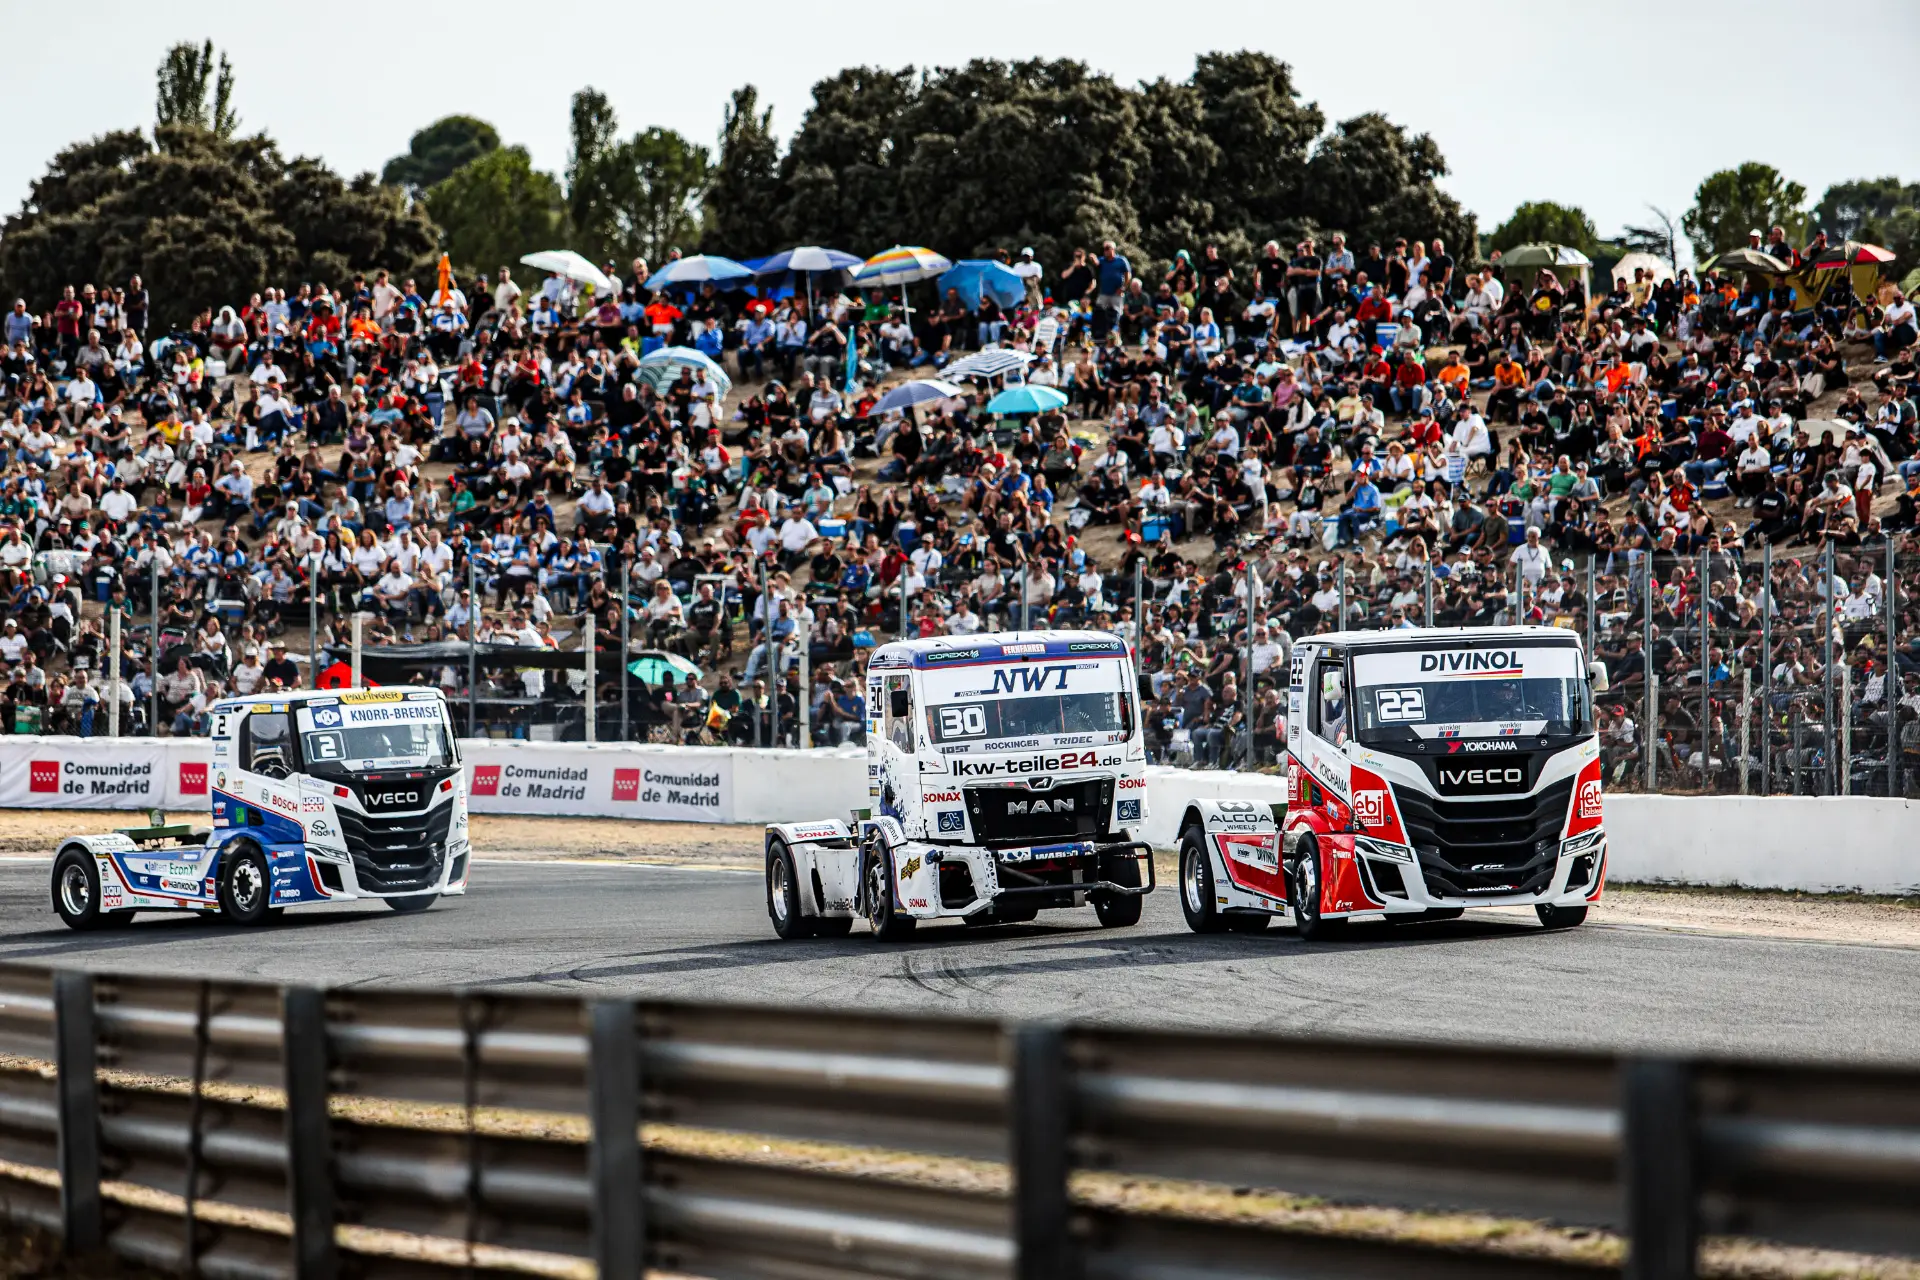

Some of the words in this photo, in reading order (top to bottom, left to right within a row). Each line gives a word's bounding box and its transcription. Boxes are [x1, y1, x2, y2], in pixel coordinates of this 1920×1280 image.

[1070, 643, 1110, 651] COREXX
[928, 651, 970, 660] COREXX
[1420, 651, 1523, 672] DIVINOL
[983, 665, 1077, 693] NWT
[1291, 658, 1303, 685] 22
[345, 691, 400, 701] PALFINGER
[870, 686, 882, 712] 30
[1380, 690, 1424, 720] 22
[350, 706, 439, 722] KNORR-BREMSE
[942, 707, 984, 736] 30
[218, 715, 226, 735] 2
[319, 735, 338, 758] 2
[985, 739, 1040, 750] ROCKINGER
[1053, 736, 1093, 745] TRIDEC
[1463, 741, 1518, 751] YOKOHAMA
[64, 762, 151, 776] Comunidad
[953, 751, 1122, 776] lkw-teile24.de
[505, 765, 588, 781] Comunidad
[644, 770, 720, 787] Comunidad
[1319, 761, 1348, 795] YOKOHAMA
[1439, 769, 1522, 785] IVECO
[63, 782, 84, 794] de
[91, 781, 150, 794] Madrid
[501, 784, 521, 796] de
[526, 785, 586, 800] Madrid
[1119, 779, 1146, 789] SONA
[272, 795, 298, 813] BOSCH
[364, 792, 419, 806] IVECO
[642, 790, 661, 802] de
[667, 791, 720, 806] Madrid
[923, 792, 961, 803] SONAX
[1007, 798, 1075, 816] MAN
[1209, 815, 1272, 823] ALCOA
[103, 886, 121, 896] LIQUI
[280, 889, 300, 898] TURBO
[103, 896, 122, 906] MOLY
[908, 898, 928, 908] SONAX
